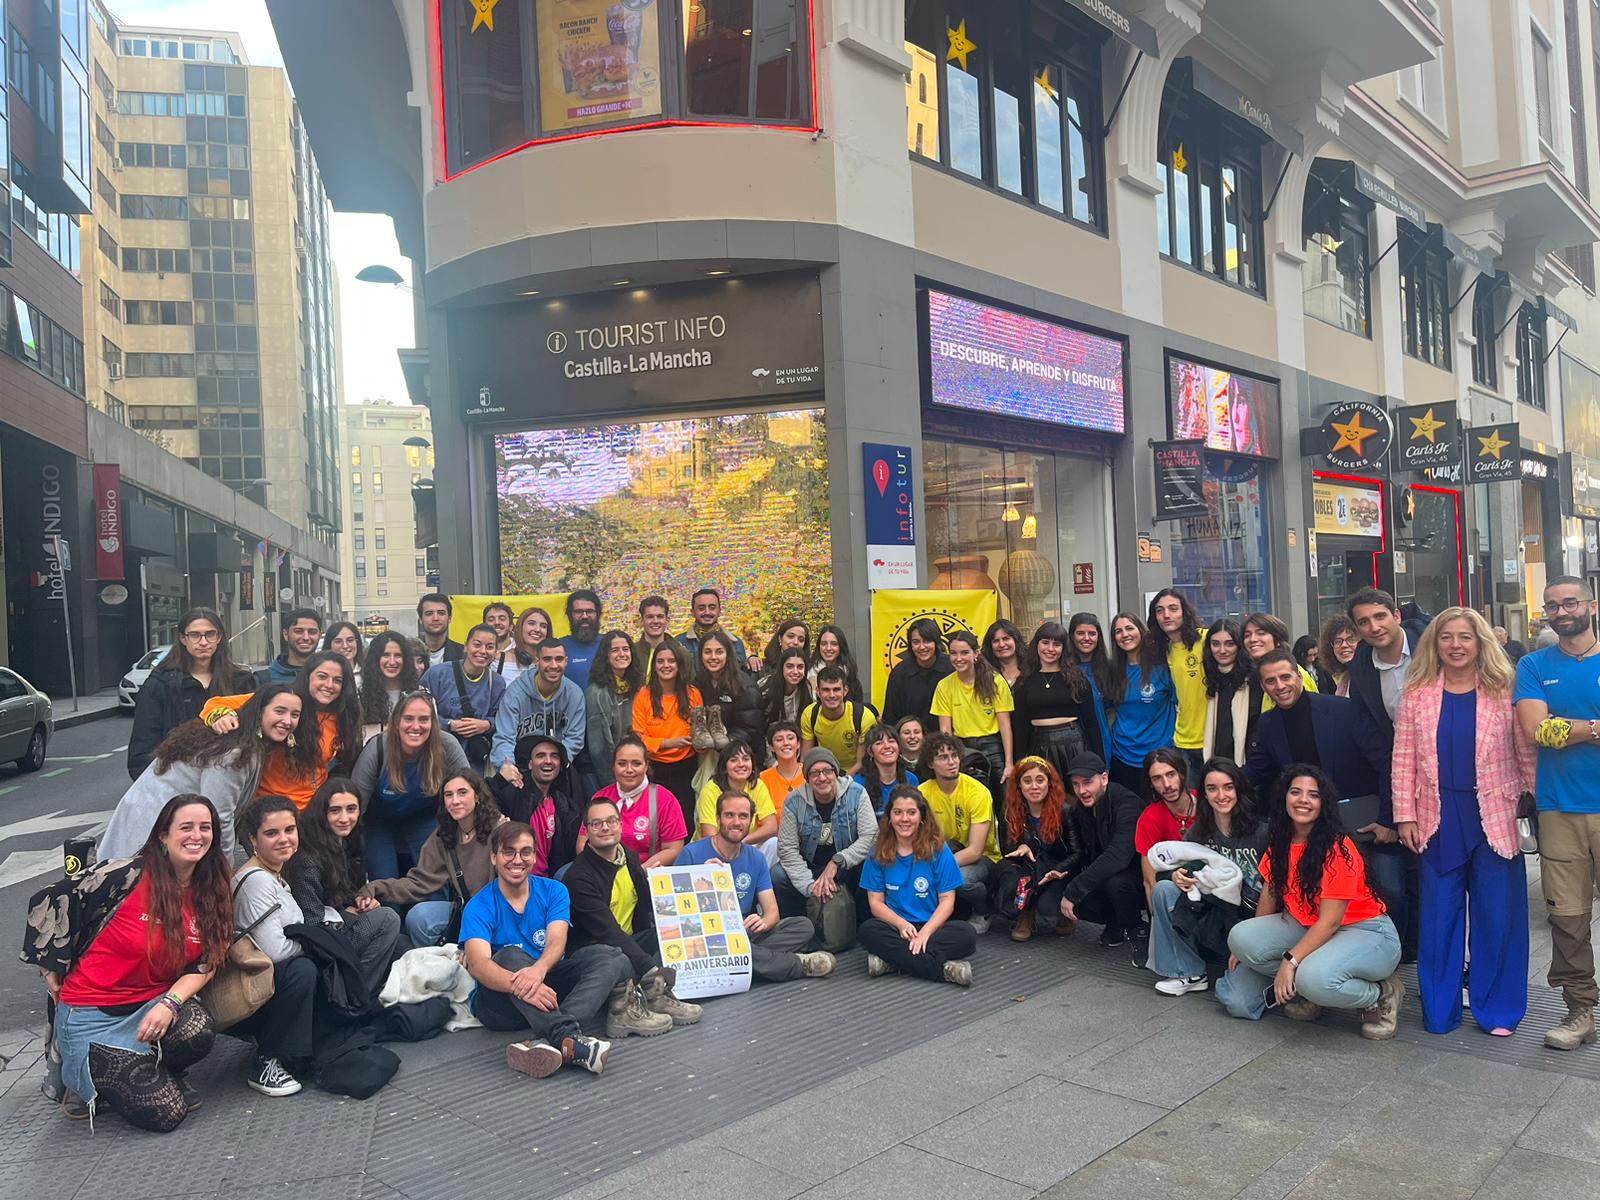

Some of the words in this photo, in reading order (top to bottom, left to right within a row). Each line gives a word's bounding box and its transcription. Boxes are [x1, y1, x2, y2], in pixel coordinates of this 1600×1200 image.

[576, 106, 597, 117] HAZLO
[597, 103, 622, 114] GRANDE
[576, 320, 668, 351] TOURIST
[674, 315, 726, 341] INFO
[650, 348, 712, 371] Mancha
[940, 341, 1009, 372] DESCUBRE,
[1011, 357, 1062, 381] APRENDE
[1062, 368, 1070, 382] Y
[1072, 371, 1118, 393] DISFRUTA
[796, 366, 819, 374] LUGAR
[1333, 403, 1385, 423] CALIFORNIA
[1156, 449, 1198, 460] CASTILLA
[1326, 452, 1369, 468] BURGERS
[1406, 444, 1435, 458] Carl's
[1474, 460, 1500, 472] Carl's
[42, 464, 62, 539] INDIGO
[896, 450, 909, 541] infotur
[107, 489, 117, 535] INDIGO
[100, 509, 108, 535] hotel
[45, 558, 65, 600] hotel
[684, 898, 691, 909] N
[708, 918, 715, 928] T
[684, 955, 749, 971] ANIVERSARIO
